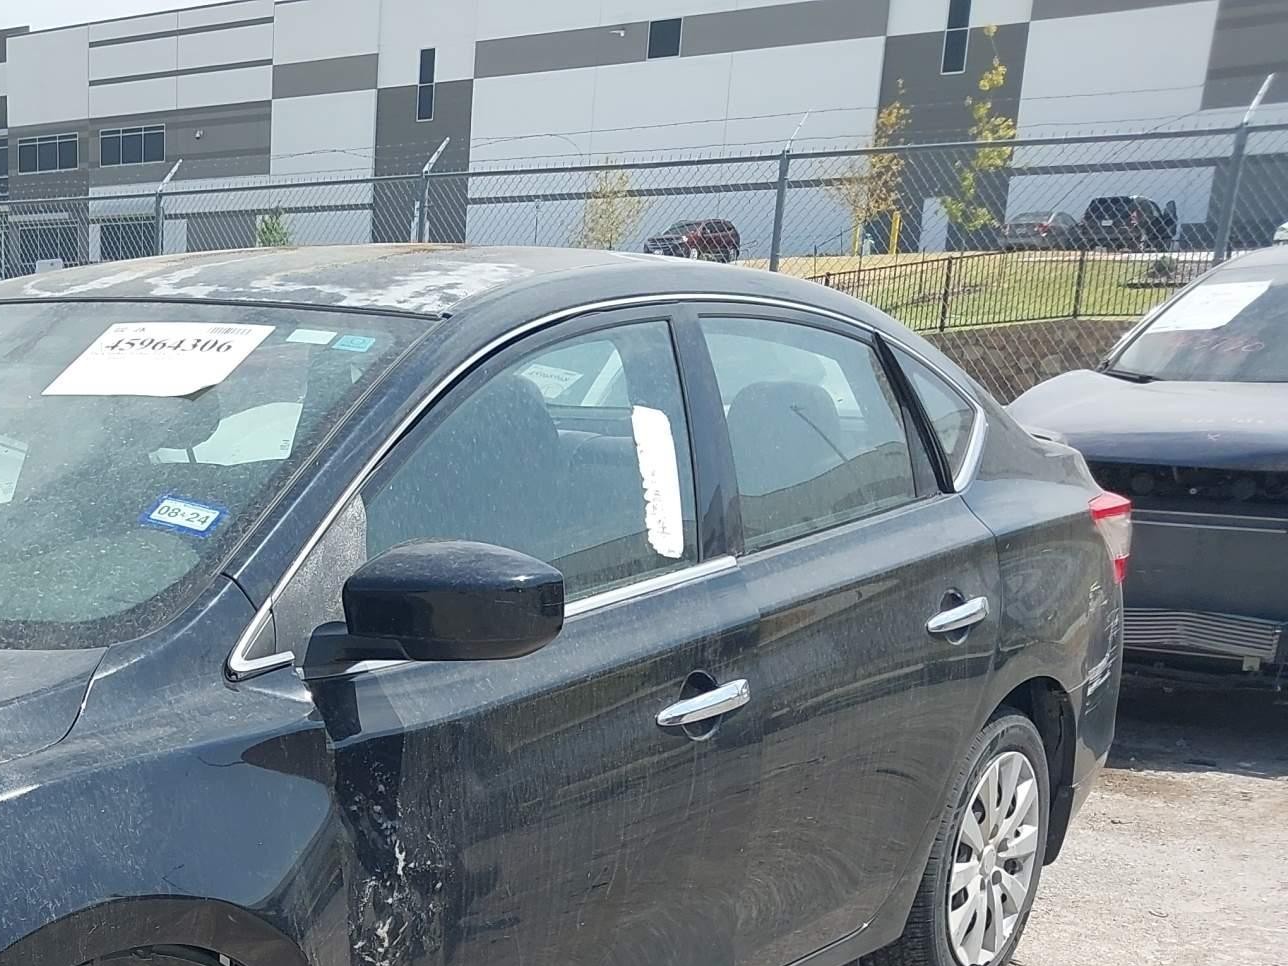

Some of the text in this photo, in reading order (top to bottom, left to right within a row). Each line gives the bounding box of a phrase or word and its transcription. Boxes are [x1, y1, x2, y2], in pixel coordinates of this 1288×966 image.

[105, 338, 233, 353] 45964306
[158, 505, 210, 525] 08 24
